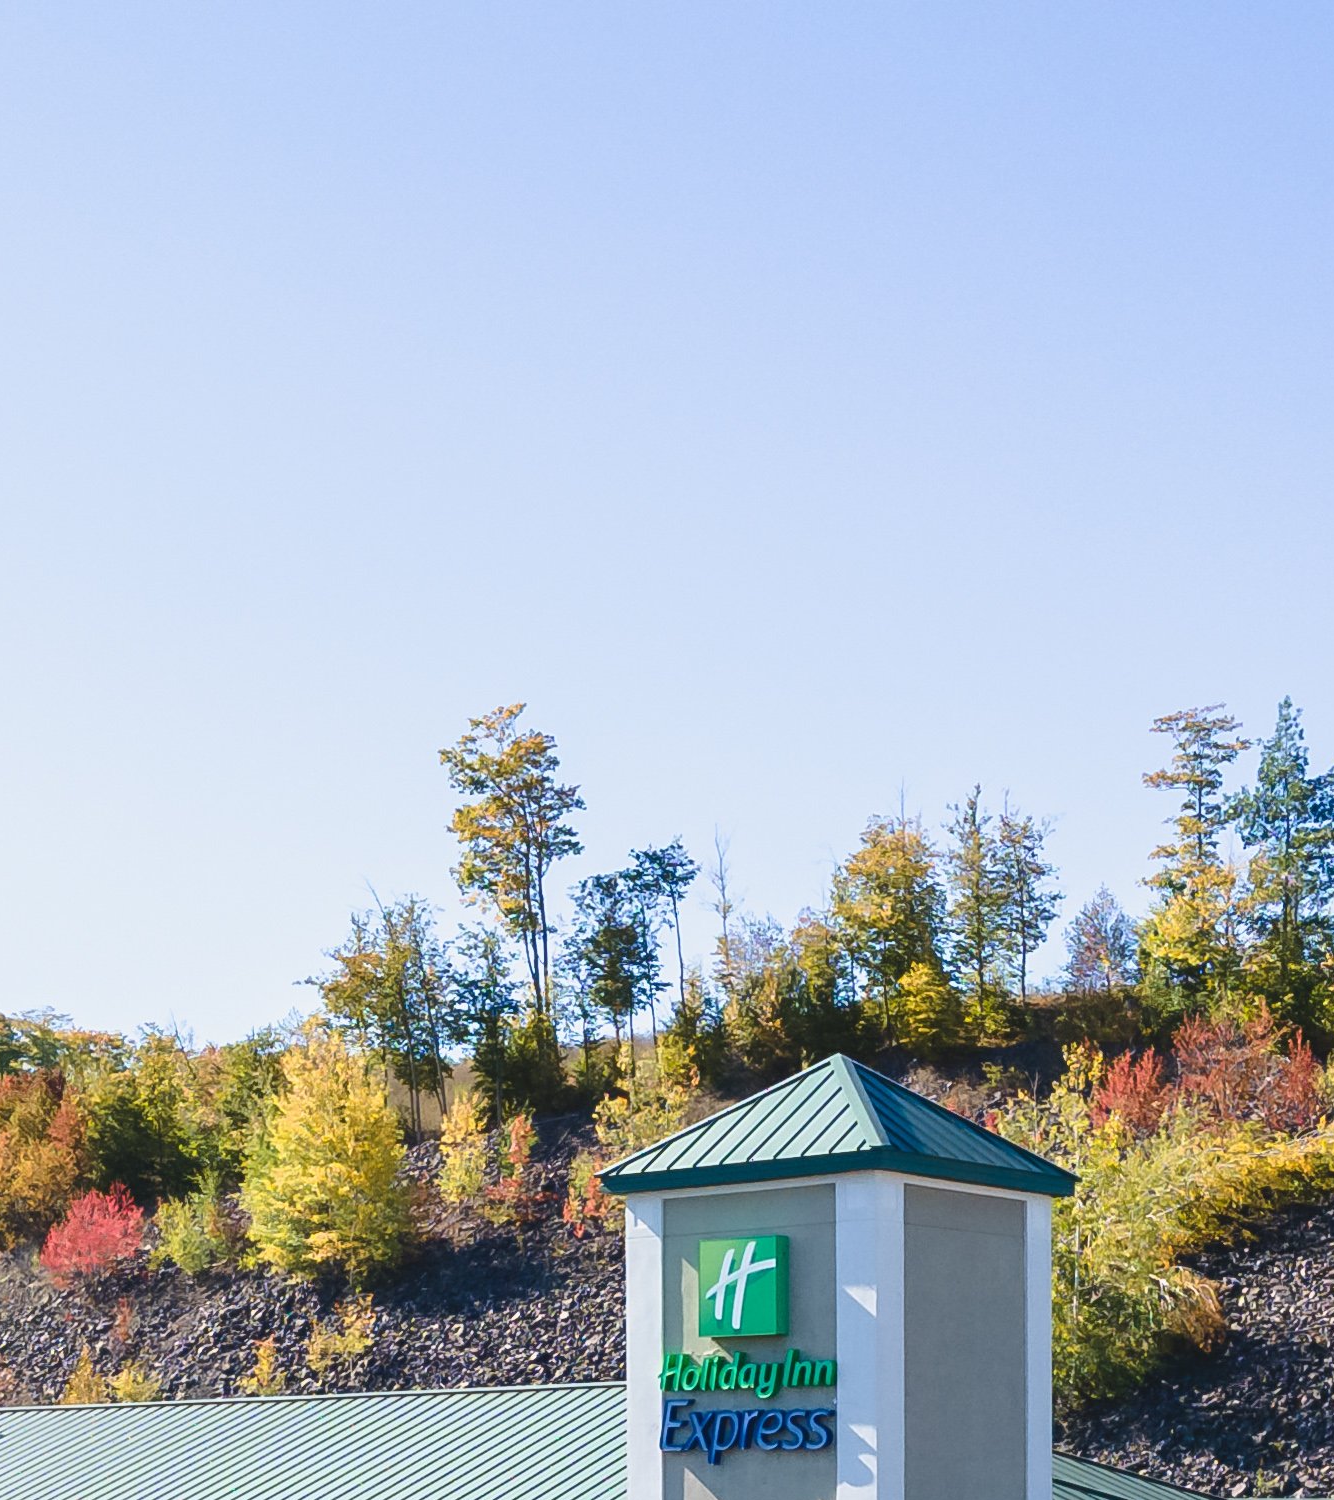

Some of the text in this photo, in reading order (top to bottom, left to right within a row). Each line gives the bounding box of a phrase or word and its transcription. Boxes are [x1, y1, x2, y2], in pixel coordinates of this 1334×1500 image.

[705, 1241, 776, 1330] H
[658, 1348, 837, 1399] Holiday Inn
[660, 1399, 834, 1465] Express
